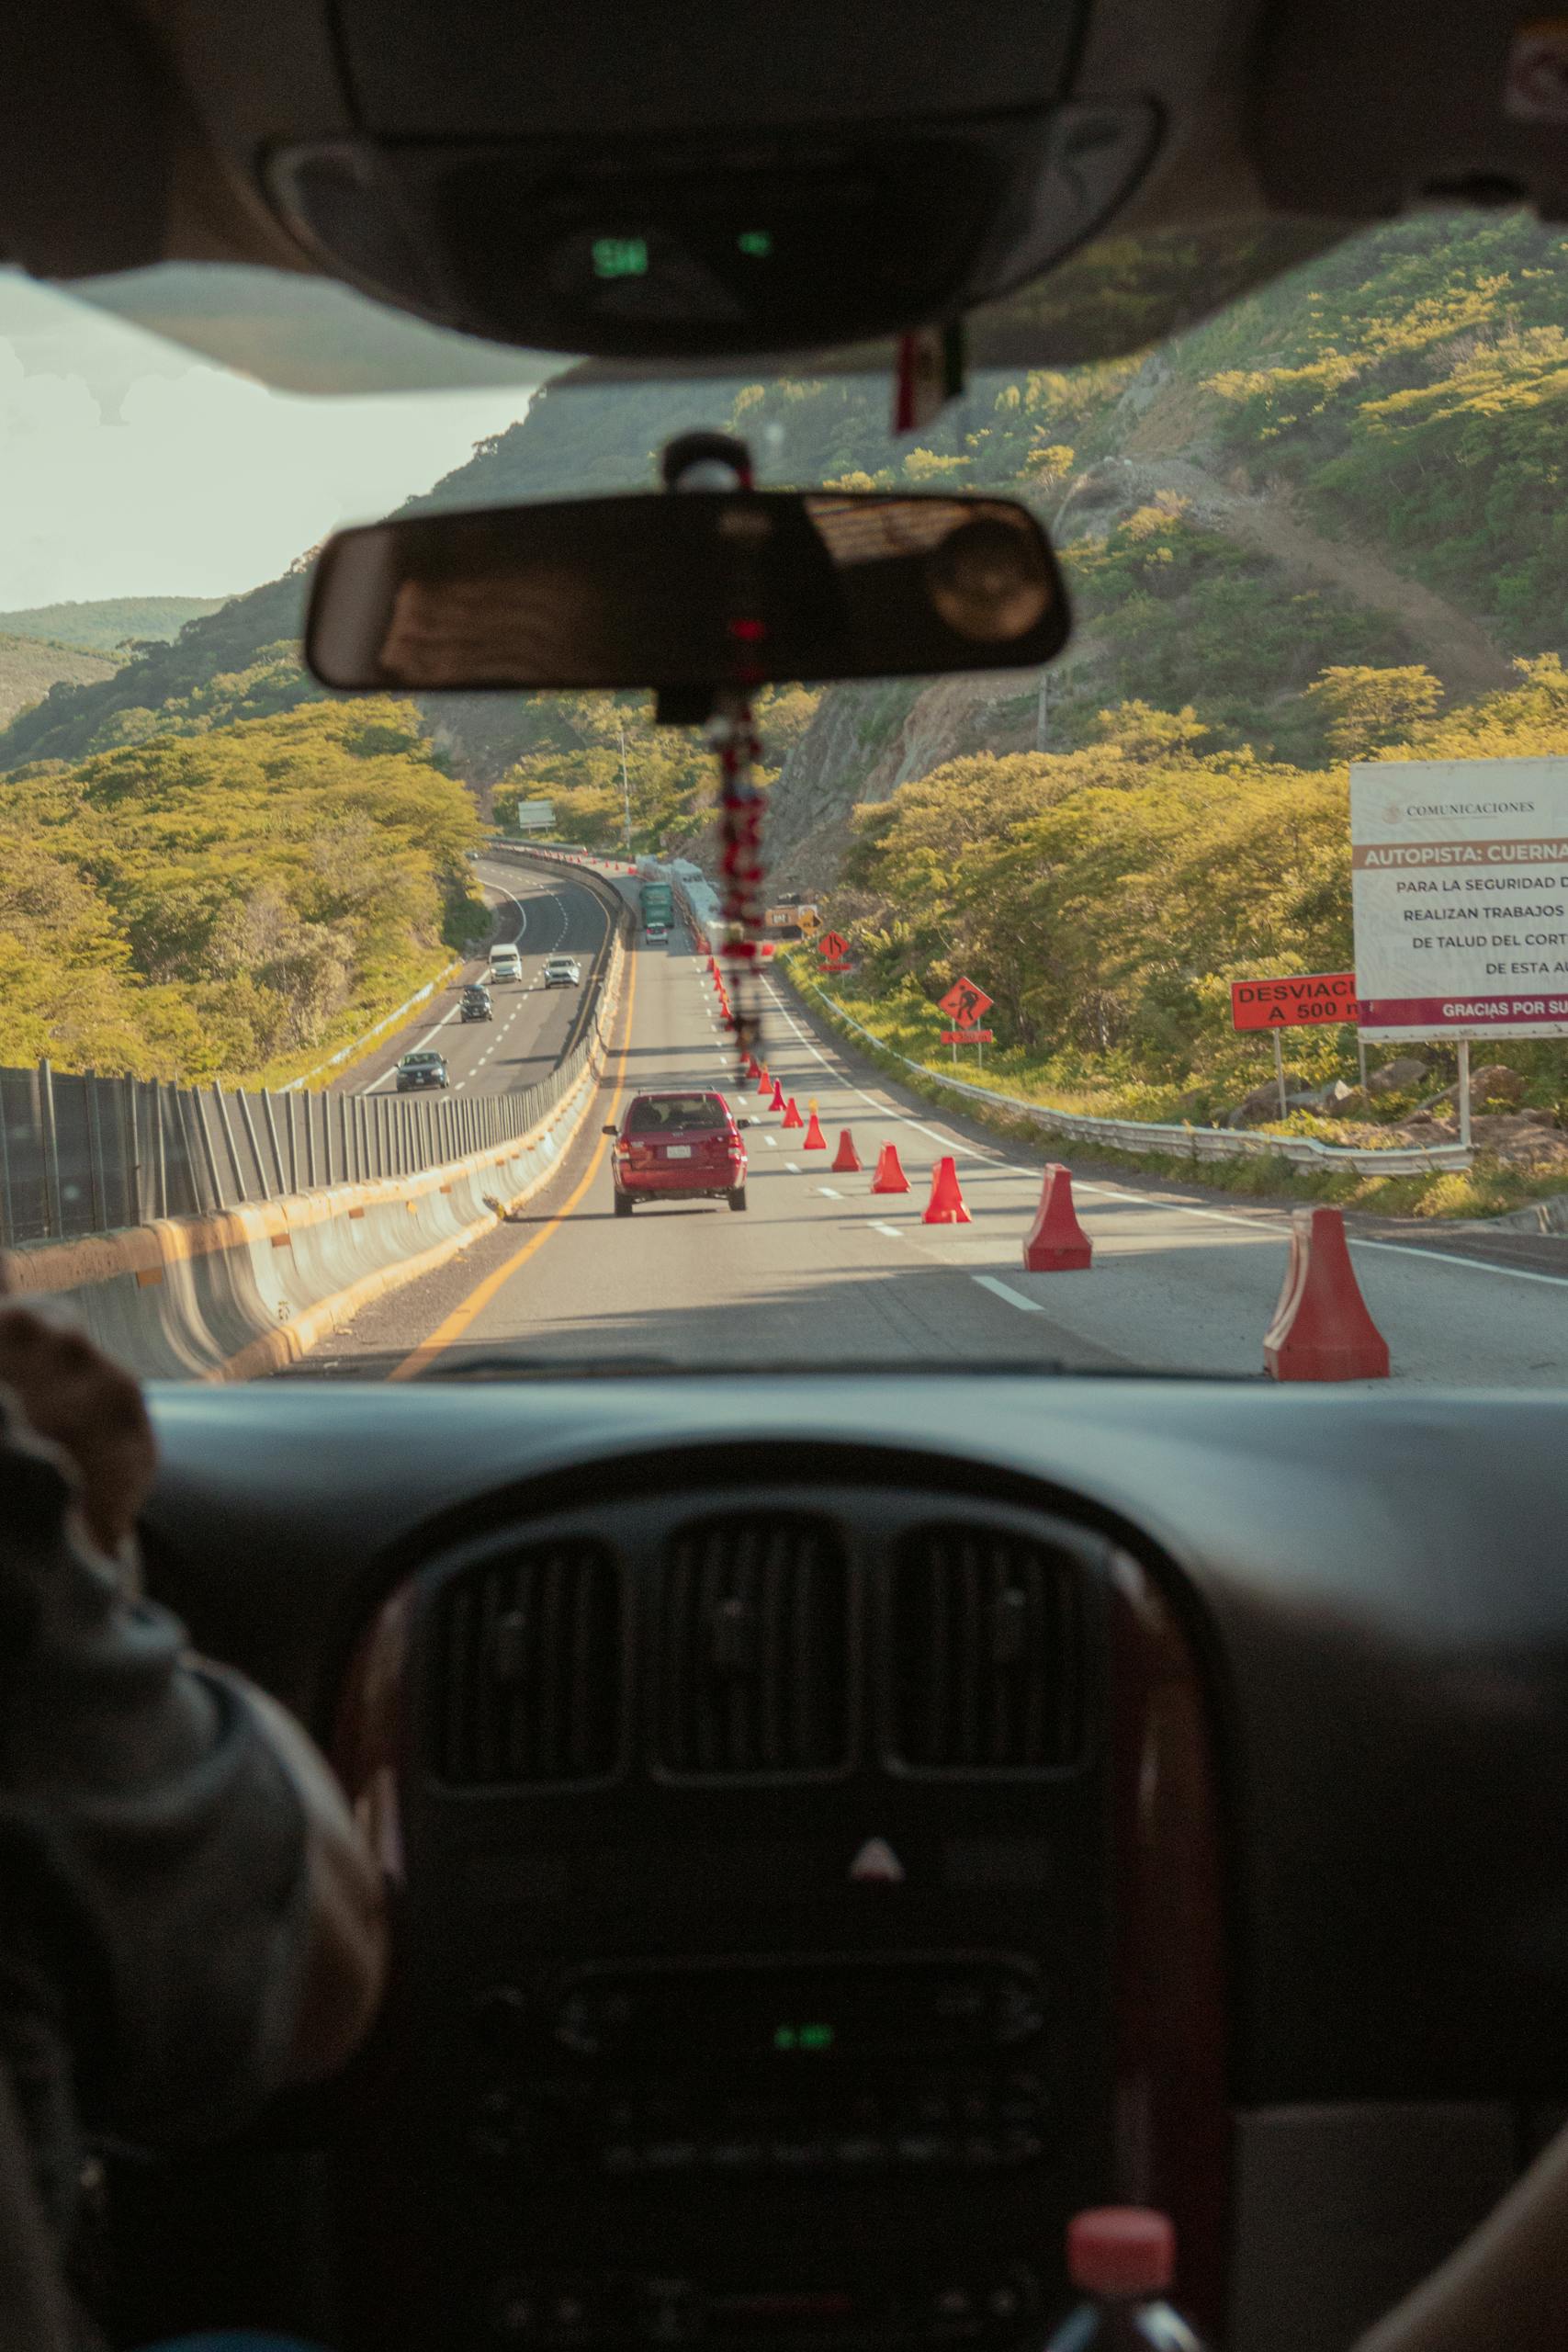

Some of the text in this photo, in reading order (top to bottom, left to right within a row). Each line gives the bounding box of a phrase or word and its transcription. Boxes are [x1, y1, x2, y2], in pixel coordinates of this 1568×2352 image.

[1406, 801, 1535, 817] COMUNICACIONES
[1364, 845, 1483, 866] AUTOPISTA:
[1396, 881, 1438, 893] PARA
[1442, 880, 1461, 892] LA
[1465, 876, 1556, 891] SEGURIDAD
[1404, 905, 1564, 922] REALIZAN TRABAJOS
[1413, 936, 1433, 949] DE
[1436, 935, 1487, 948] TALUD
[1492, 934, 1520, 946] DEL
[1486, 963, 1506, 975] DE
[1511, 962, 1550, 974] ESTA
[1269, 1006, 1285, 1021] A
[1297, 1001, 1337, 1020] 500
[1442, 1001, 1509, 1017] GRACIAS
[1513, 1001, 1545, 1014] POR
